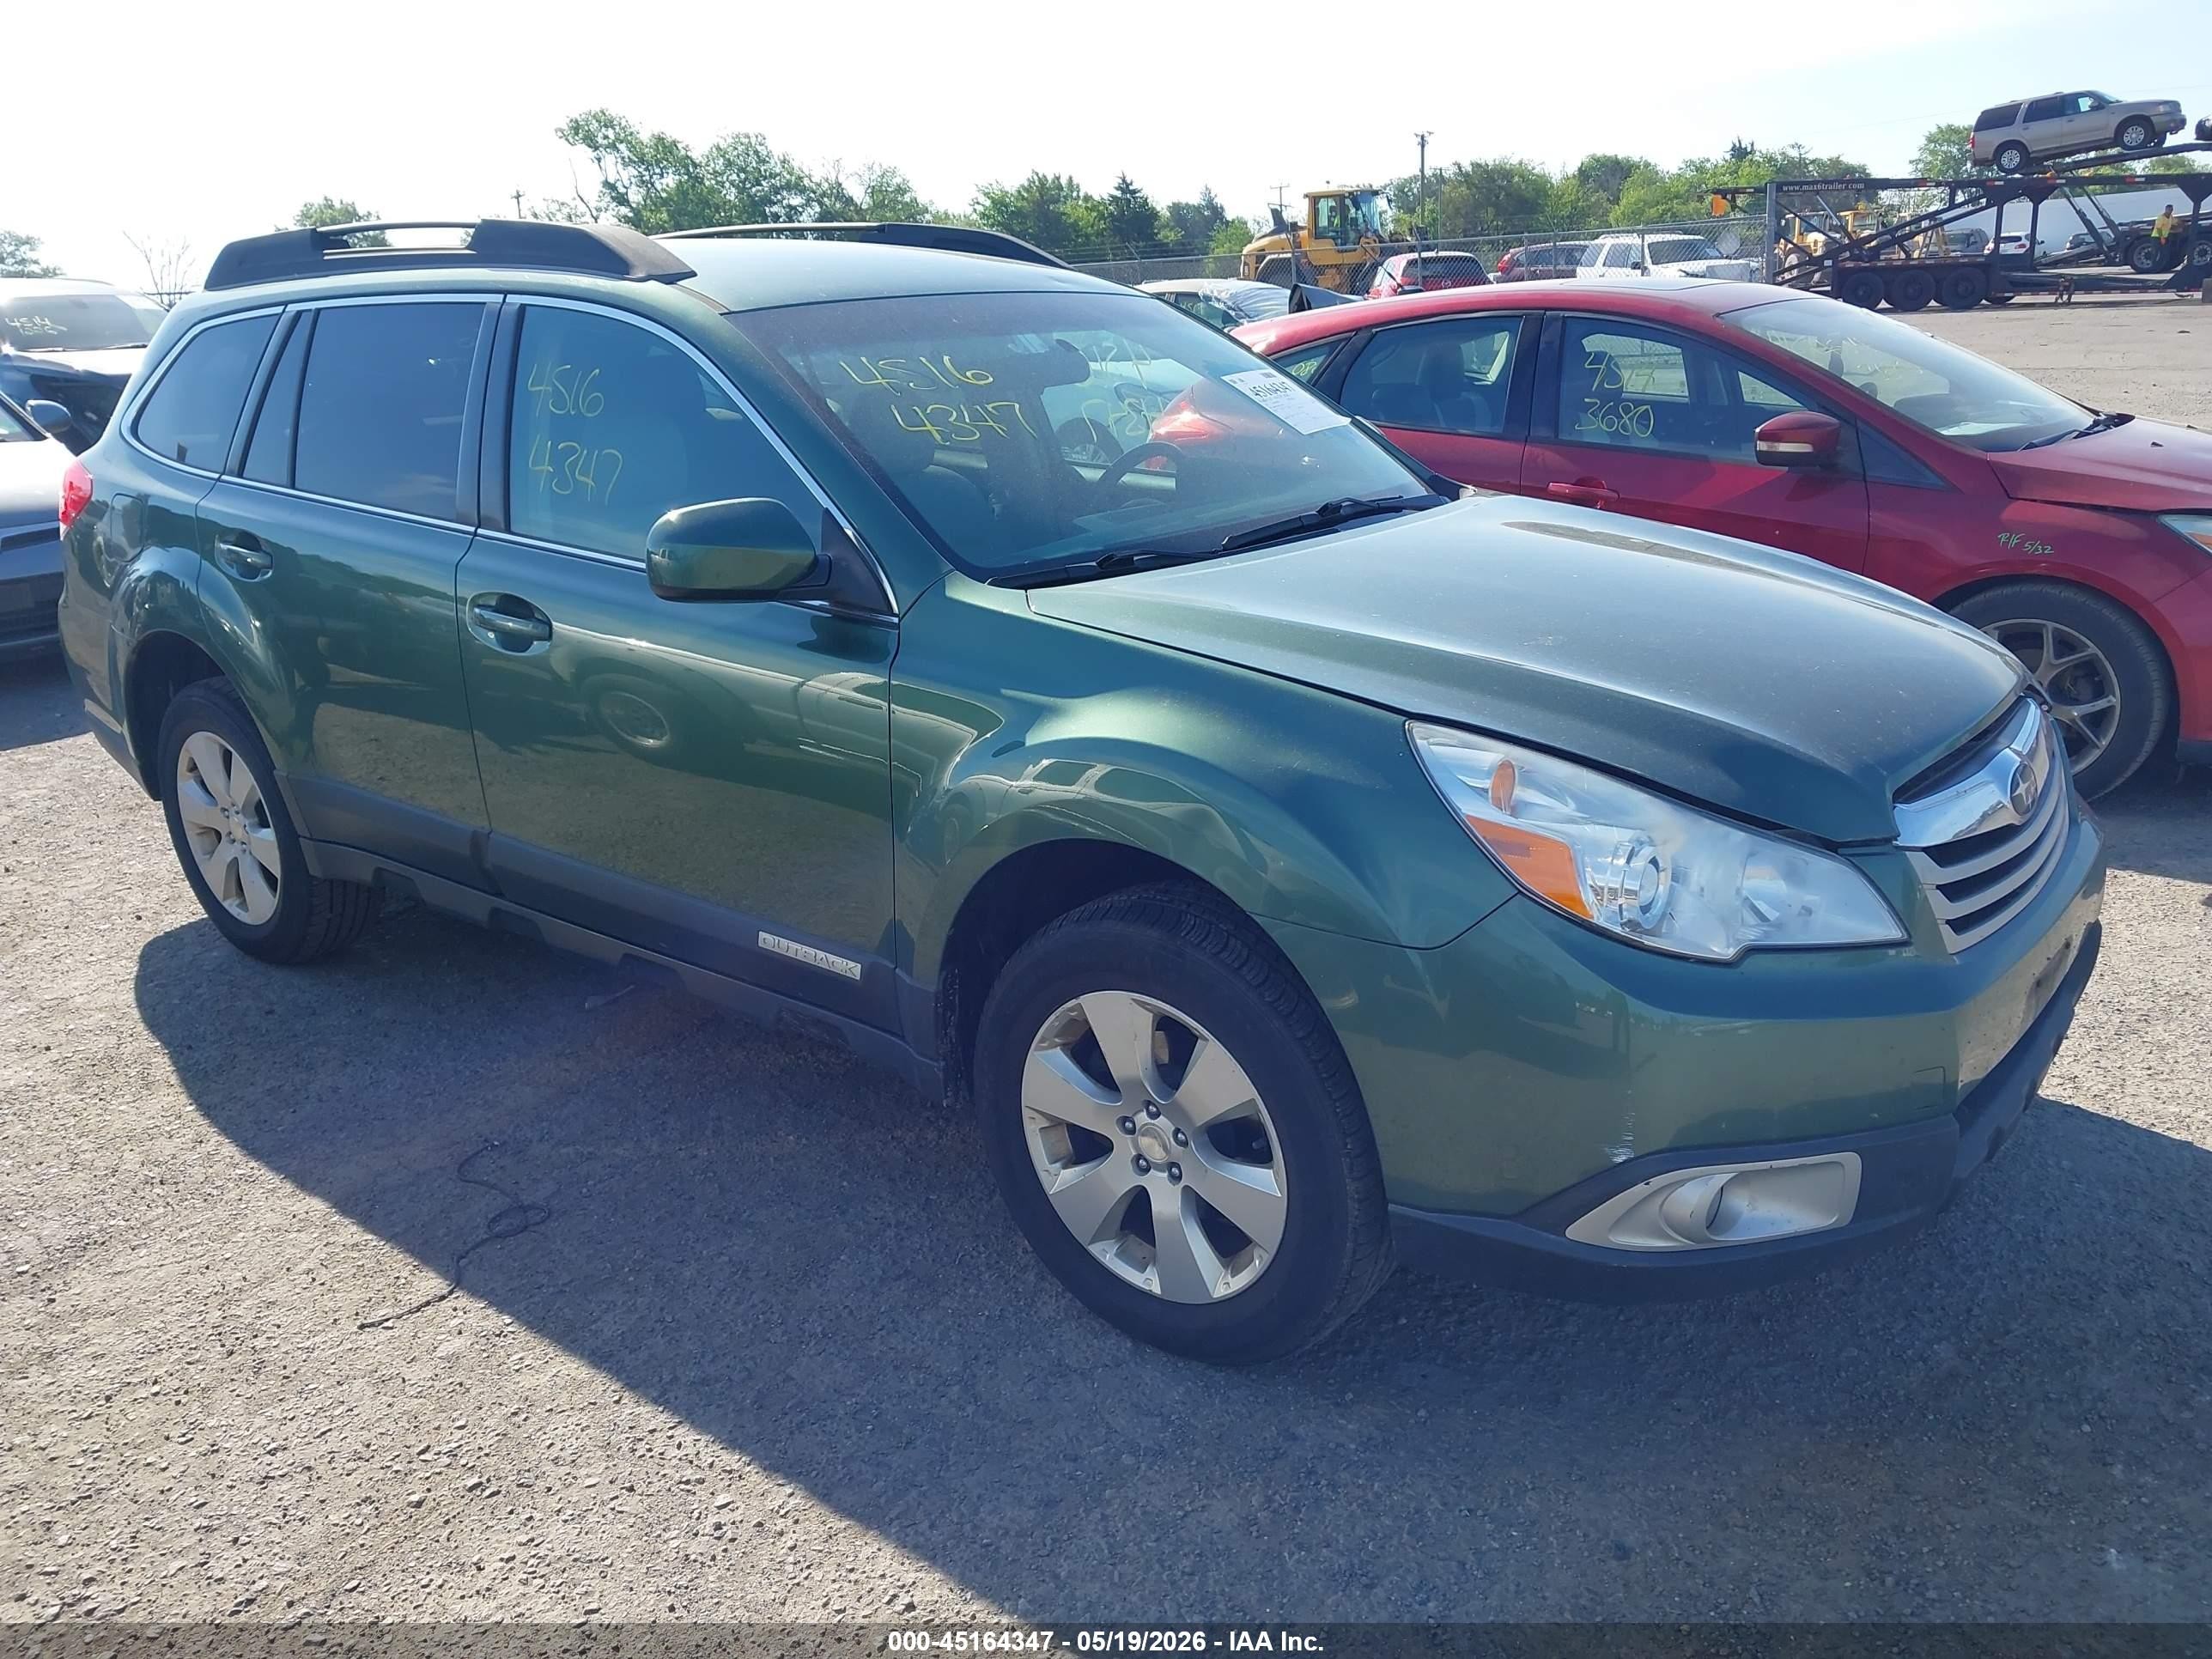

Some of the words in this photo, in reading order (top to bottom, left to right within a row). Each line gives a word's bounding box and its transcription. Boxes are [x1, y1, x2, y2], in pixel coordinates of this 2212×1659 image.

[527, 363, 604, 417] 4516
[840, 347, 994, 396] 4516
[890, 402, 1037, 445] 4347
[1575, 398, 1655, 437] 3680
[529, 434, 623, 505] 4347
[2022, 540, 2055, 555] 5/32
[763, 934, 859, 978] OUTBACK
